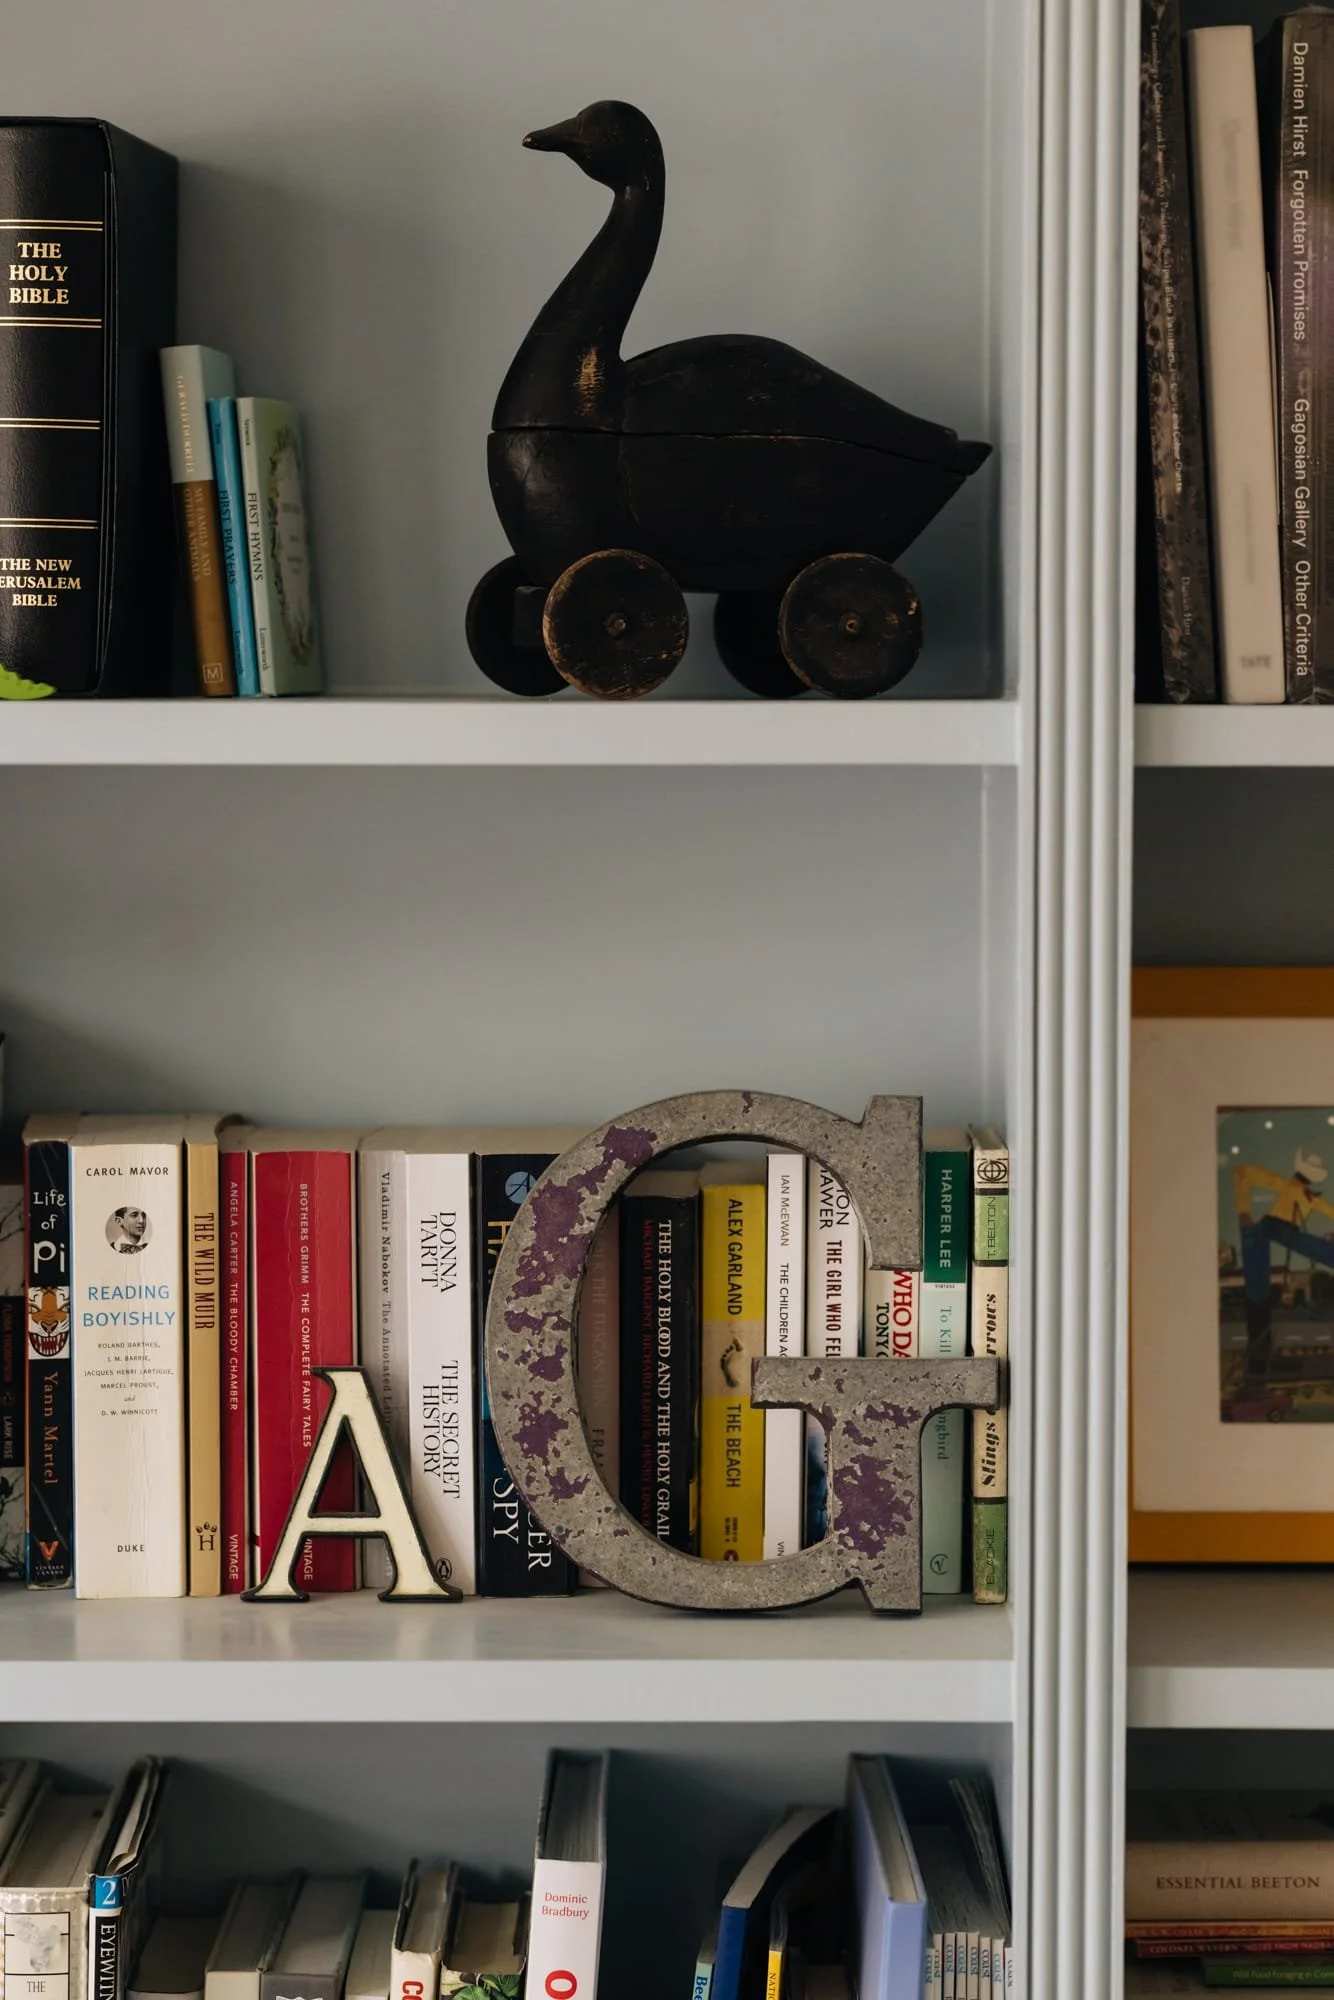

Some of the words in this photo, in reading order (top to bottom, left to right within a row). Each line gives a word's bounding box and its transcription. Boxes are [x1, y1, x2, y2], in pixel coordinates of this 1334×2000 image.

[1293, 42, 1309, 110] Damien
[1293, 115, 1309, 158] Hirst
[1289, 169, 1309, 256] Forgotten
[17, 242, 62, 259] THE
[9, 264, 69, 282] HOLY
[9, 287, 70, 305] BIBLE
[1292, 259, 1309, 341] Promises
[1292, 398, 1311, 481] Gagosian
[219, 489, 232, 525] FIRST
[247, 492, 261, 528] FIRST
[1292, 485, 1311, 548] Gallery
[0, 558, 32, 571] THE
[35, 558, 73, 572] NEW
[223, 528, 237, 586] PRAYERS
[250, 531, 264, 582] HYMNS
[12, 594, 58, 607] BIBLE
[1295, 559, 1312, 609] Other
[1295, 612, 1312, 677] Criteria
[86, 1168, 124, 1177] CAROL
[129, 1167, 169, 1176] MAVOR
[780, 1174, 790, 1193] IAN
[33, 1189, 67, 1207] Life
[229, 1181, 239, 1228] ANGELA
[299, 1183, 310, 1241] BROTHERS
[381, 1172, 390, 1232] Vladimir
[941, 1169, 953, 1234] HARPER
[41, 1214, 58, 1230] of
[193, 1213, 215, 1242] THE
[658, 1219, 672, 1254] THE
[727, 1199, 742, 1237] ALEX
[779, 1197, 790, 1247] McEWAN
[33, 1240, 66, 1274] Pi
[229, 1231, 239, 1275] CARTER
[382, 1235, 391, 1294] Nabokov
[421, 1215, 439, 1287] TARTT
[439, 1211, 458, 1294] DONNA
[643, 1220, 653, 1270] MICHAEL
[825, 1240, 842, 1267] THE
[940, 1239, 952, 1269] LEE
[193, 1248, 215, 1286] WILD
[300, 1245, 310, 1285] GRIMM
[658, 1259, 672, 1303] HOLY
[727, 1241, 742, 1315] GARLAND
[779, 1263, 789, 1285] THE
[825, 1269, 842, 1300] GIRL
[88, 1285, 170, 1301] READING
[193, 1291, 215, 1330] MUIR
[229, 1282, 239, 1304] THE
[301, 1292, 311, 1314] THE
[383, 1300, 392, 1324] The
[892, 1270, 913, 1327] WHO
[83, 1311, 176, 1328] BOYISHLY
[229, 1307, 239, 1353] BLOODY
[658, 1306, 672, 1358] BLOOD
[779, 1288, 789, 1343] CHILDREN
[825, 1302, 842, 1331] WHO
[876, 1302, 890, 1350] TONY
[939, 1306, 952, 1323] To
[301, 1317, 312, 1377] COMPLETE
[939, 1328, 952, 1354] Kill
[84, 1369, 114, 1377] JACQUES
[383, 1327, 392, 1397] Annotated
[658, 1361, 672, 1400] AND
[44, 1371, 58, 1418] Yann
[229, 1356, 239, 1411] CHAMBER
[301, 1380, 312, 1412] FAIRY
[441, 1360, 460, 1404] THE
[3, 1416, 13, 1438] LARK
[302, 1415, 312, 1449] TALES
[422, 1384, 441, 1479] HISTORY
[657, 1402, 671, 1437] THE
[725, 1404, 741, 1433] THE
[44, 1425, 60, 1484] Martel
[442, 1411, 461, 1499] SECRET
[657, 1441, 671, 1485] HOLY
[725, 1437, 741, 1489] BEACH
[981, 1421, 1000, 1488] Slings
[492, 1477, 519, 1544] SPY
[656, 1488, 670, 1540] GRAIL
[117, 1544, 145, 1553] DUKE
[229, 1534, 239, 1581] VINTAGE
[102, 1880, 117, 1906] 2
[544, 1892, 589, 1904] Dominic
[1156, 1877, 1245, 1889] ESSENTIAL
[1251, 1876, 1320, 1889] BEETON
[541, 1905, 590, 1921] Bradbury
[27, 1981, 46, 1993] THE
